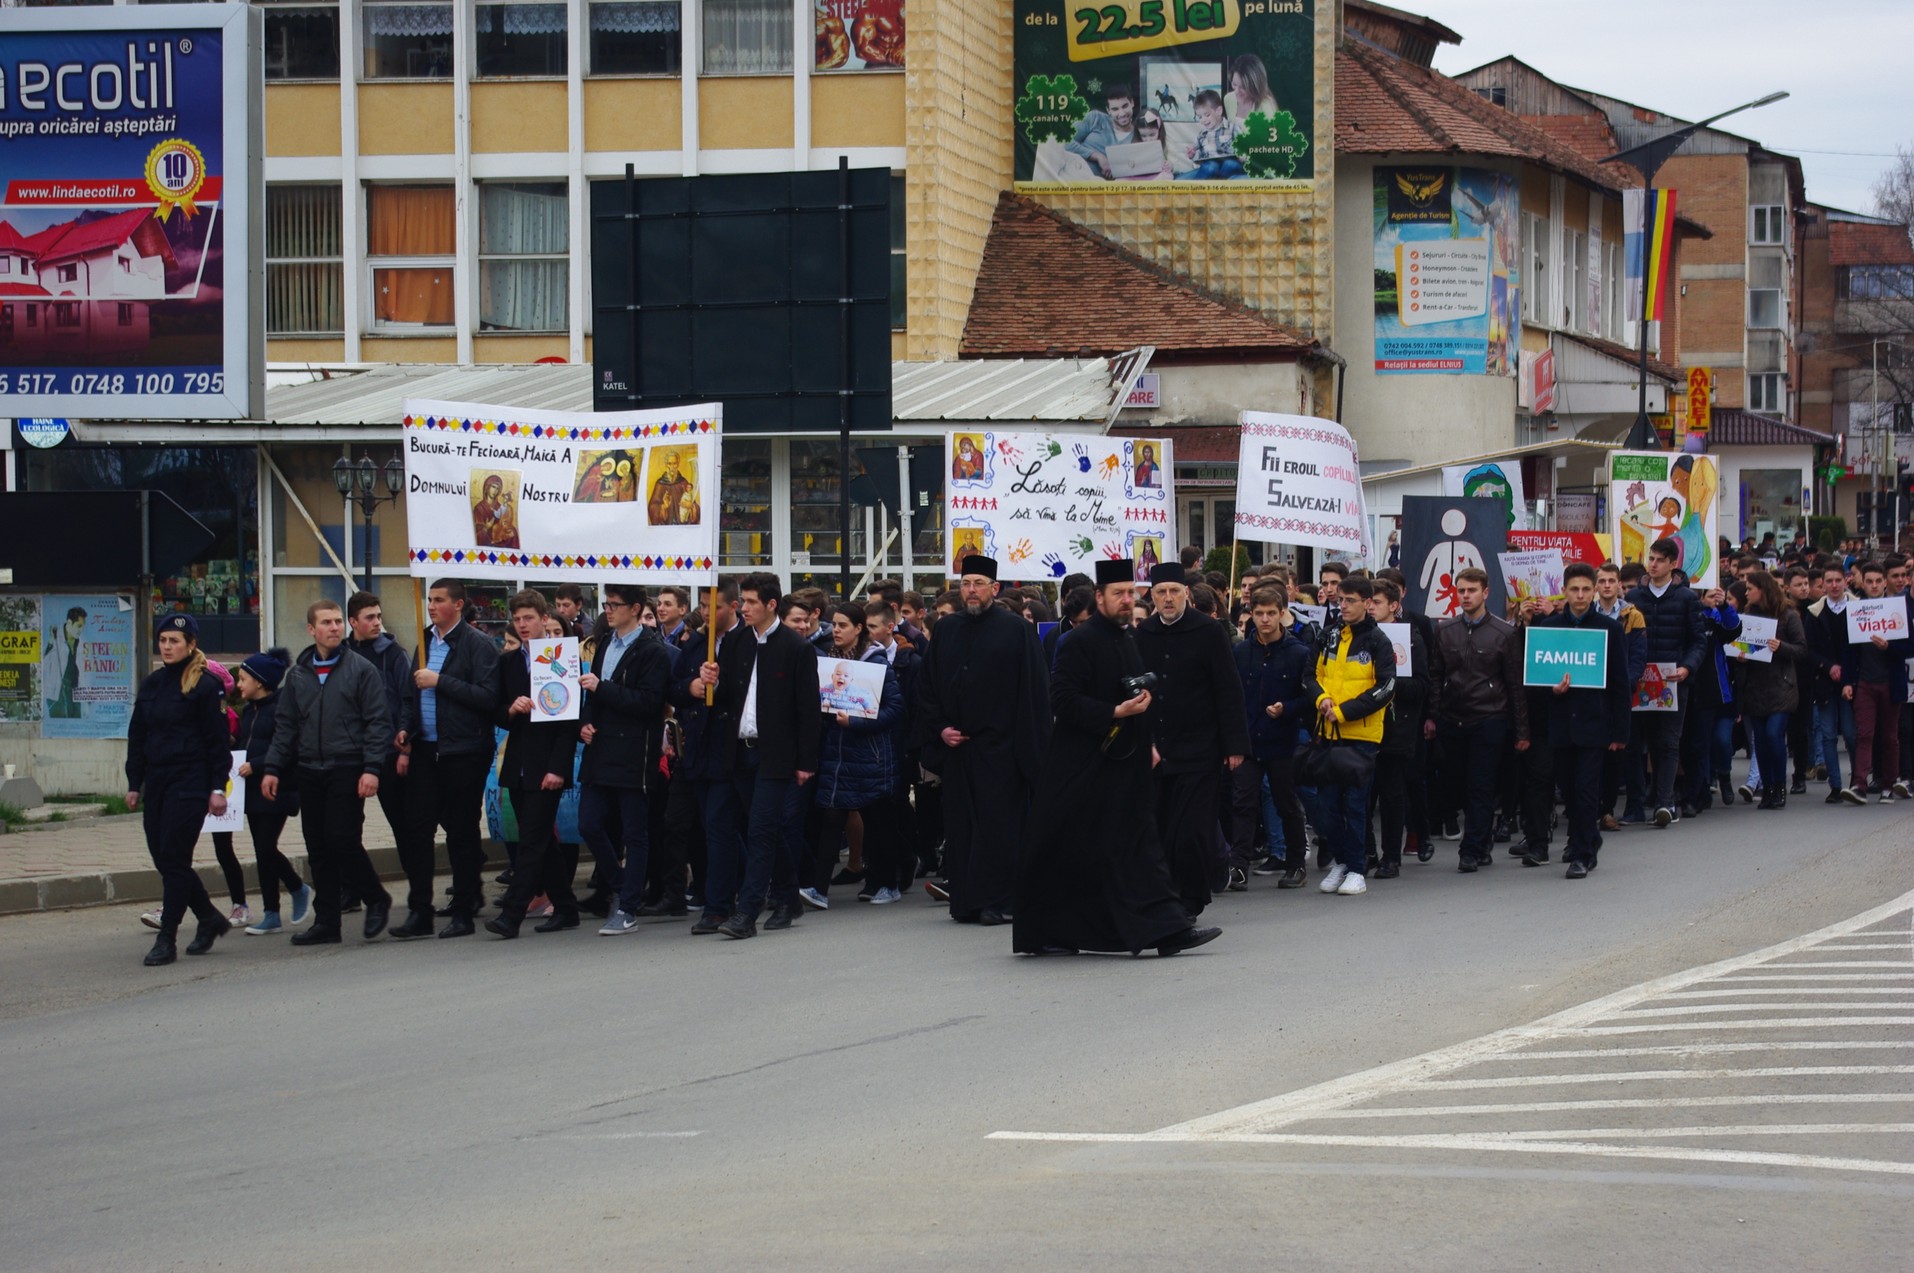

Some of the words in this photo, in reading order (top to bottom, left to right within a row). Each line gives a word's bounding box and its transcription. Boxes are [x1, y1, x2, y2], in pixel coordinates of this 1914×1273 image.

[1245, 1, 1265, 17] pe
[1268, 0, 1303, 14] lună
[1025, 13, 1042, 26] de
[1046, 13, 1058, 26] la
[1036, 95, 1069, 110] 119
[1032, 114, 1058, 123] canale
[1059, 115, 1071, 123] TV
[39, 117, 100, 135] oricărei
[1267, 128, 1278, 143] 3
[1248, 145, 1280, 155] pachete
[1281, 145, 1294, 154] HD
[162, 154, 187, 179] 10
[167, 178, 184, 188] ani
[18, 185, 136, 199] www.lindaecotil.ro
[1419, 211, 1428, 219] de
[1429, 211, 1450, 219] Turism
[1422, 265, 1457, 273] Honeymoon
[1384, 349, 1443, 357] office@yustrans.ro
[1409, 361, 1416, 369] la
[1417, 361, 1439, 369] sediul
[70, 374, 125, 394] 0748
[136, 373, 175, 393] 100
[184, 372, 224, 393] 795
[603, 382, 629, 390] KATEL
[1690, 367, 1709, 426] AMANET
[561, 446, 573, 464] A
[1283, 460, 1320, 477] EROUL
[522, 482, 570, 504] NOSTRU
[1510, 535, 1546, 546] PENTRU
[1534, 650, 1597, 666] FAMILIE
